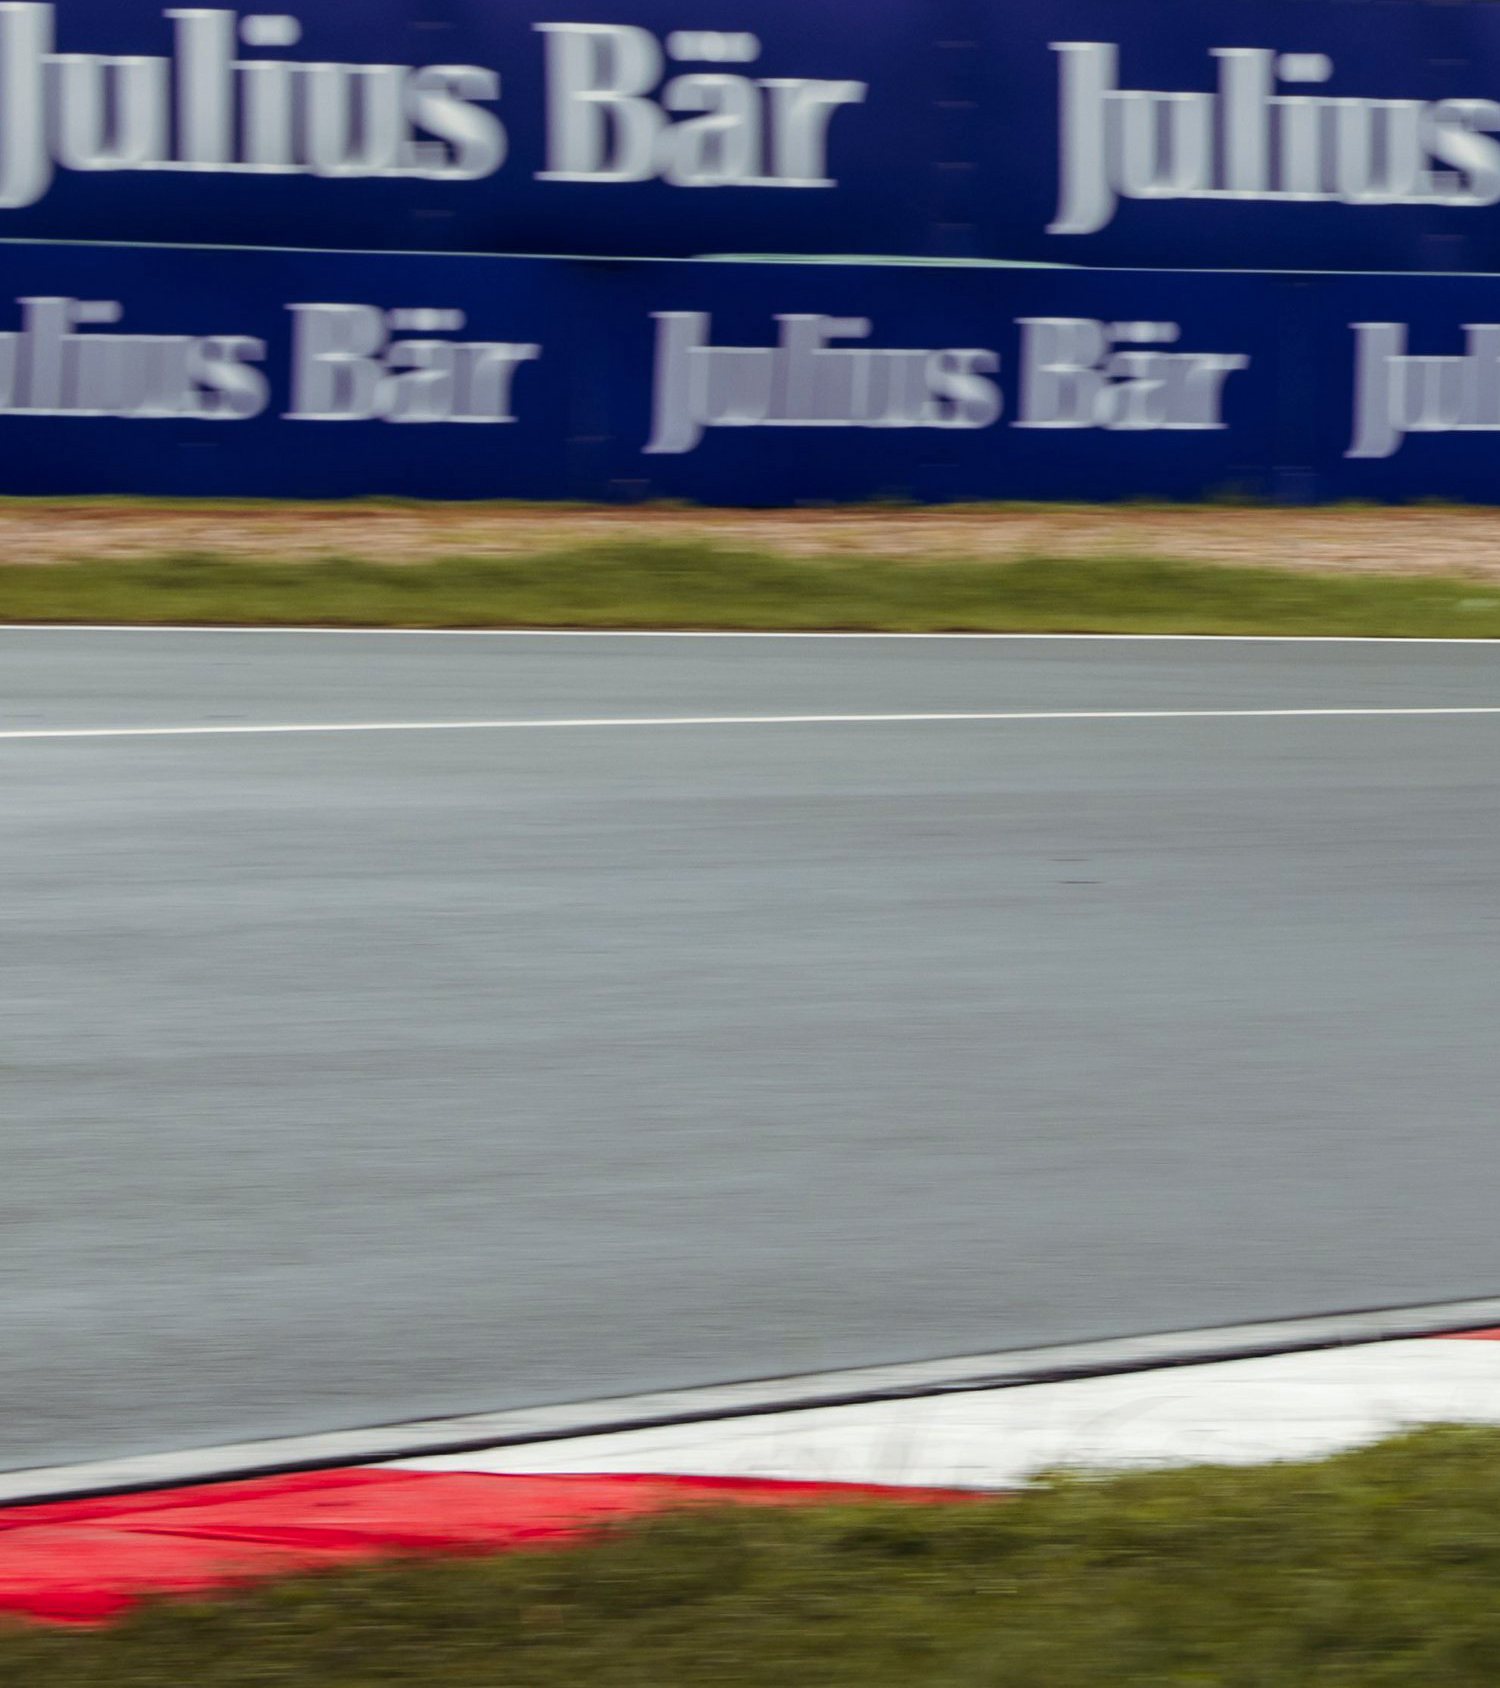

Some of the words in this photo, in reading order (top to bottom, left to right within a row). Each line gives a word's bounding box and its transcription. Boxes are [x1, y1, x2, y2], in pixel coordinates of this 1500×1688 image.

[531, 20, 868, 189] Bär
[0, 295, 271, 422] lius
[278, 301, 541, 425] Bär
[642, 309, 1003, 455] Julius
[1010, 315, 1250, 432] Bär
